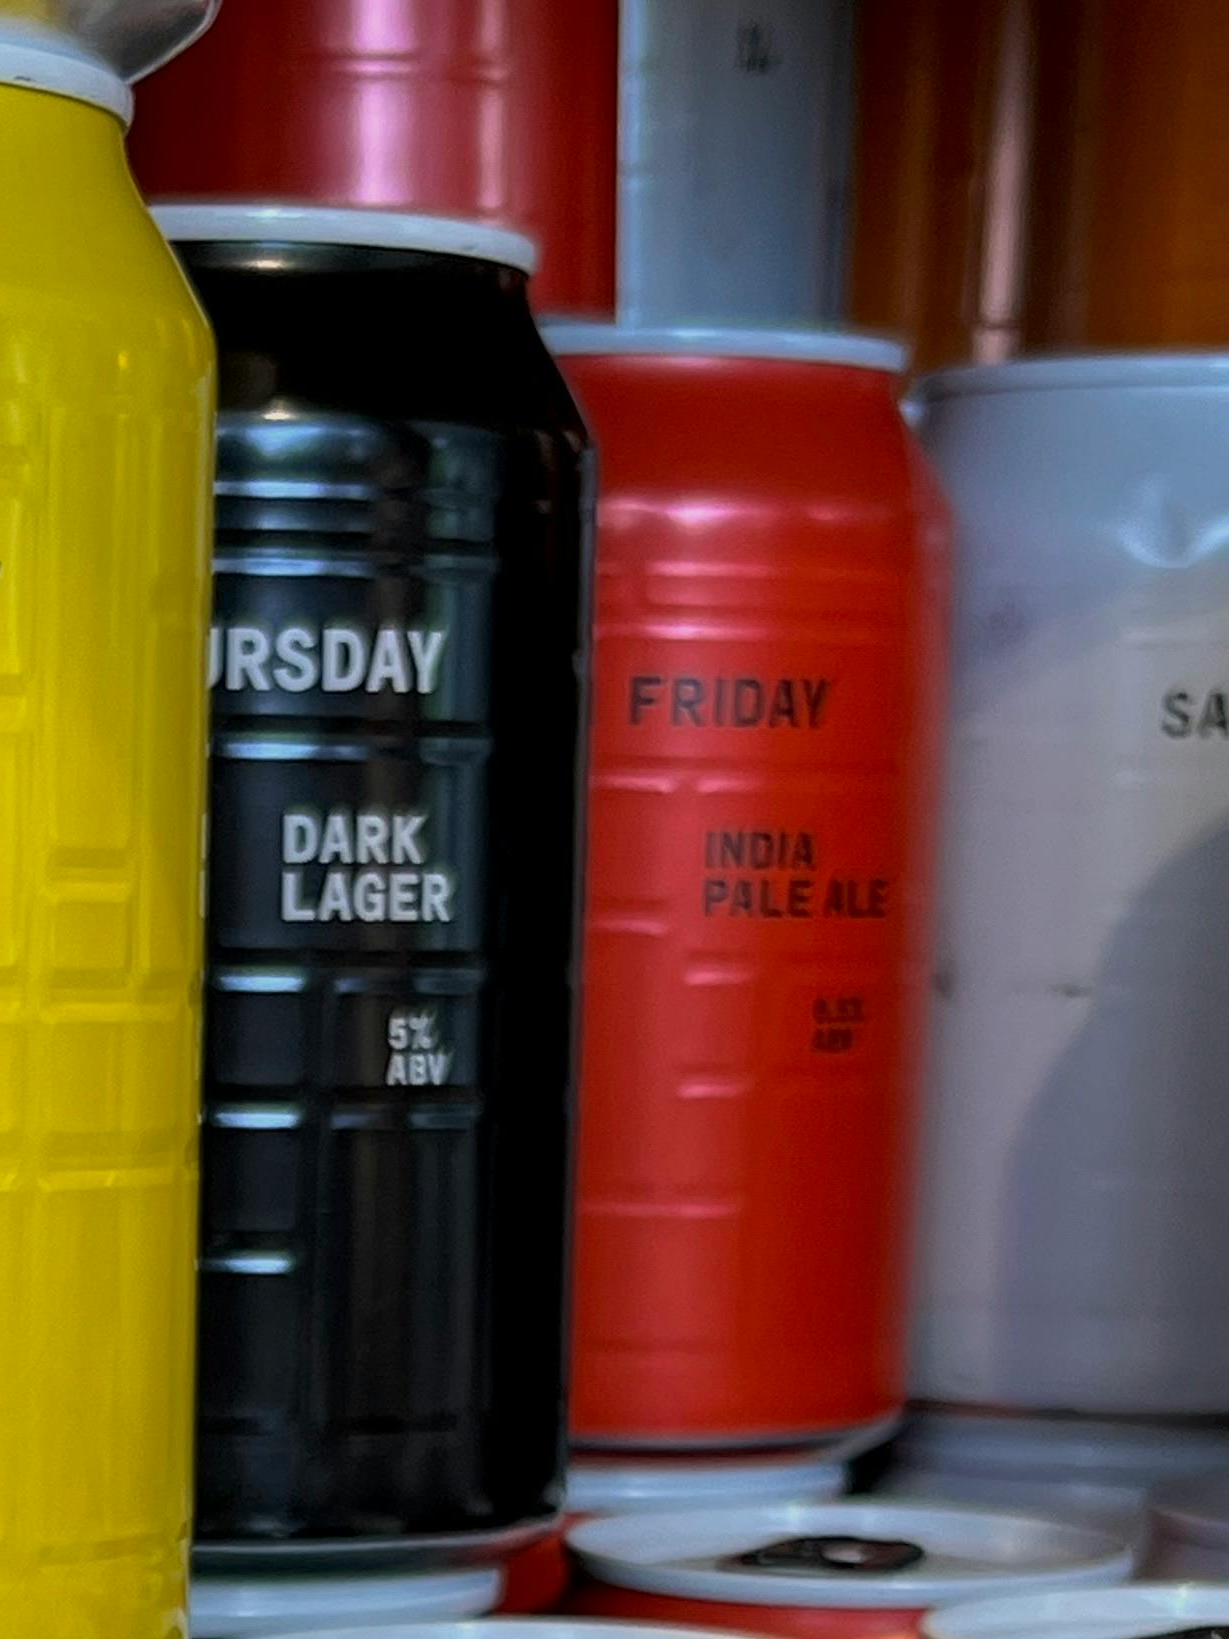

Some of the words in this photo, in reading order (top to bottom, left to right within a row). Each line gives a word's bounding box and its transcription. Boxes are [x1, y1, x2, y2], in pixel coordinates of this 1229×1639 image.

[628, 675, 832, 729] FRIDAY
[283, 813, 425, 865] DARK
[705, 829, 817, 871] INDIA
[281, 872, 452, 922] LAGER
[703, 877, 813, 919] PALE
[824, 877, 890, 919] ALE
[387, 1014, 435, 1050] 5%
[386, 1053, 449, 1086] ABV
